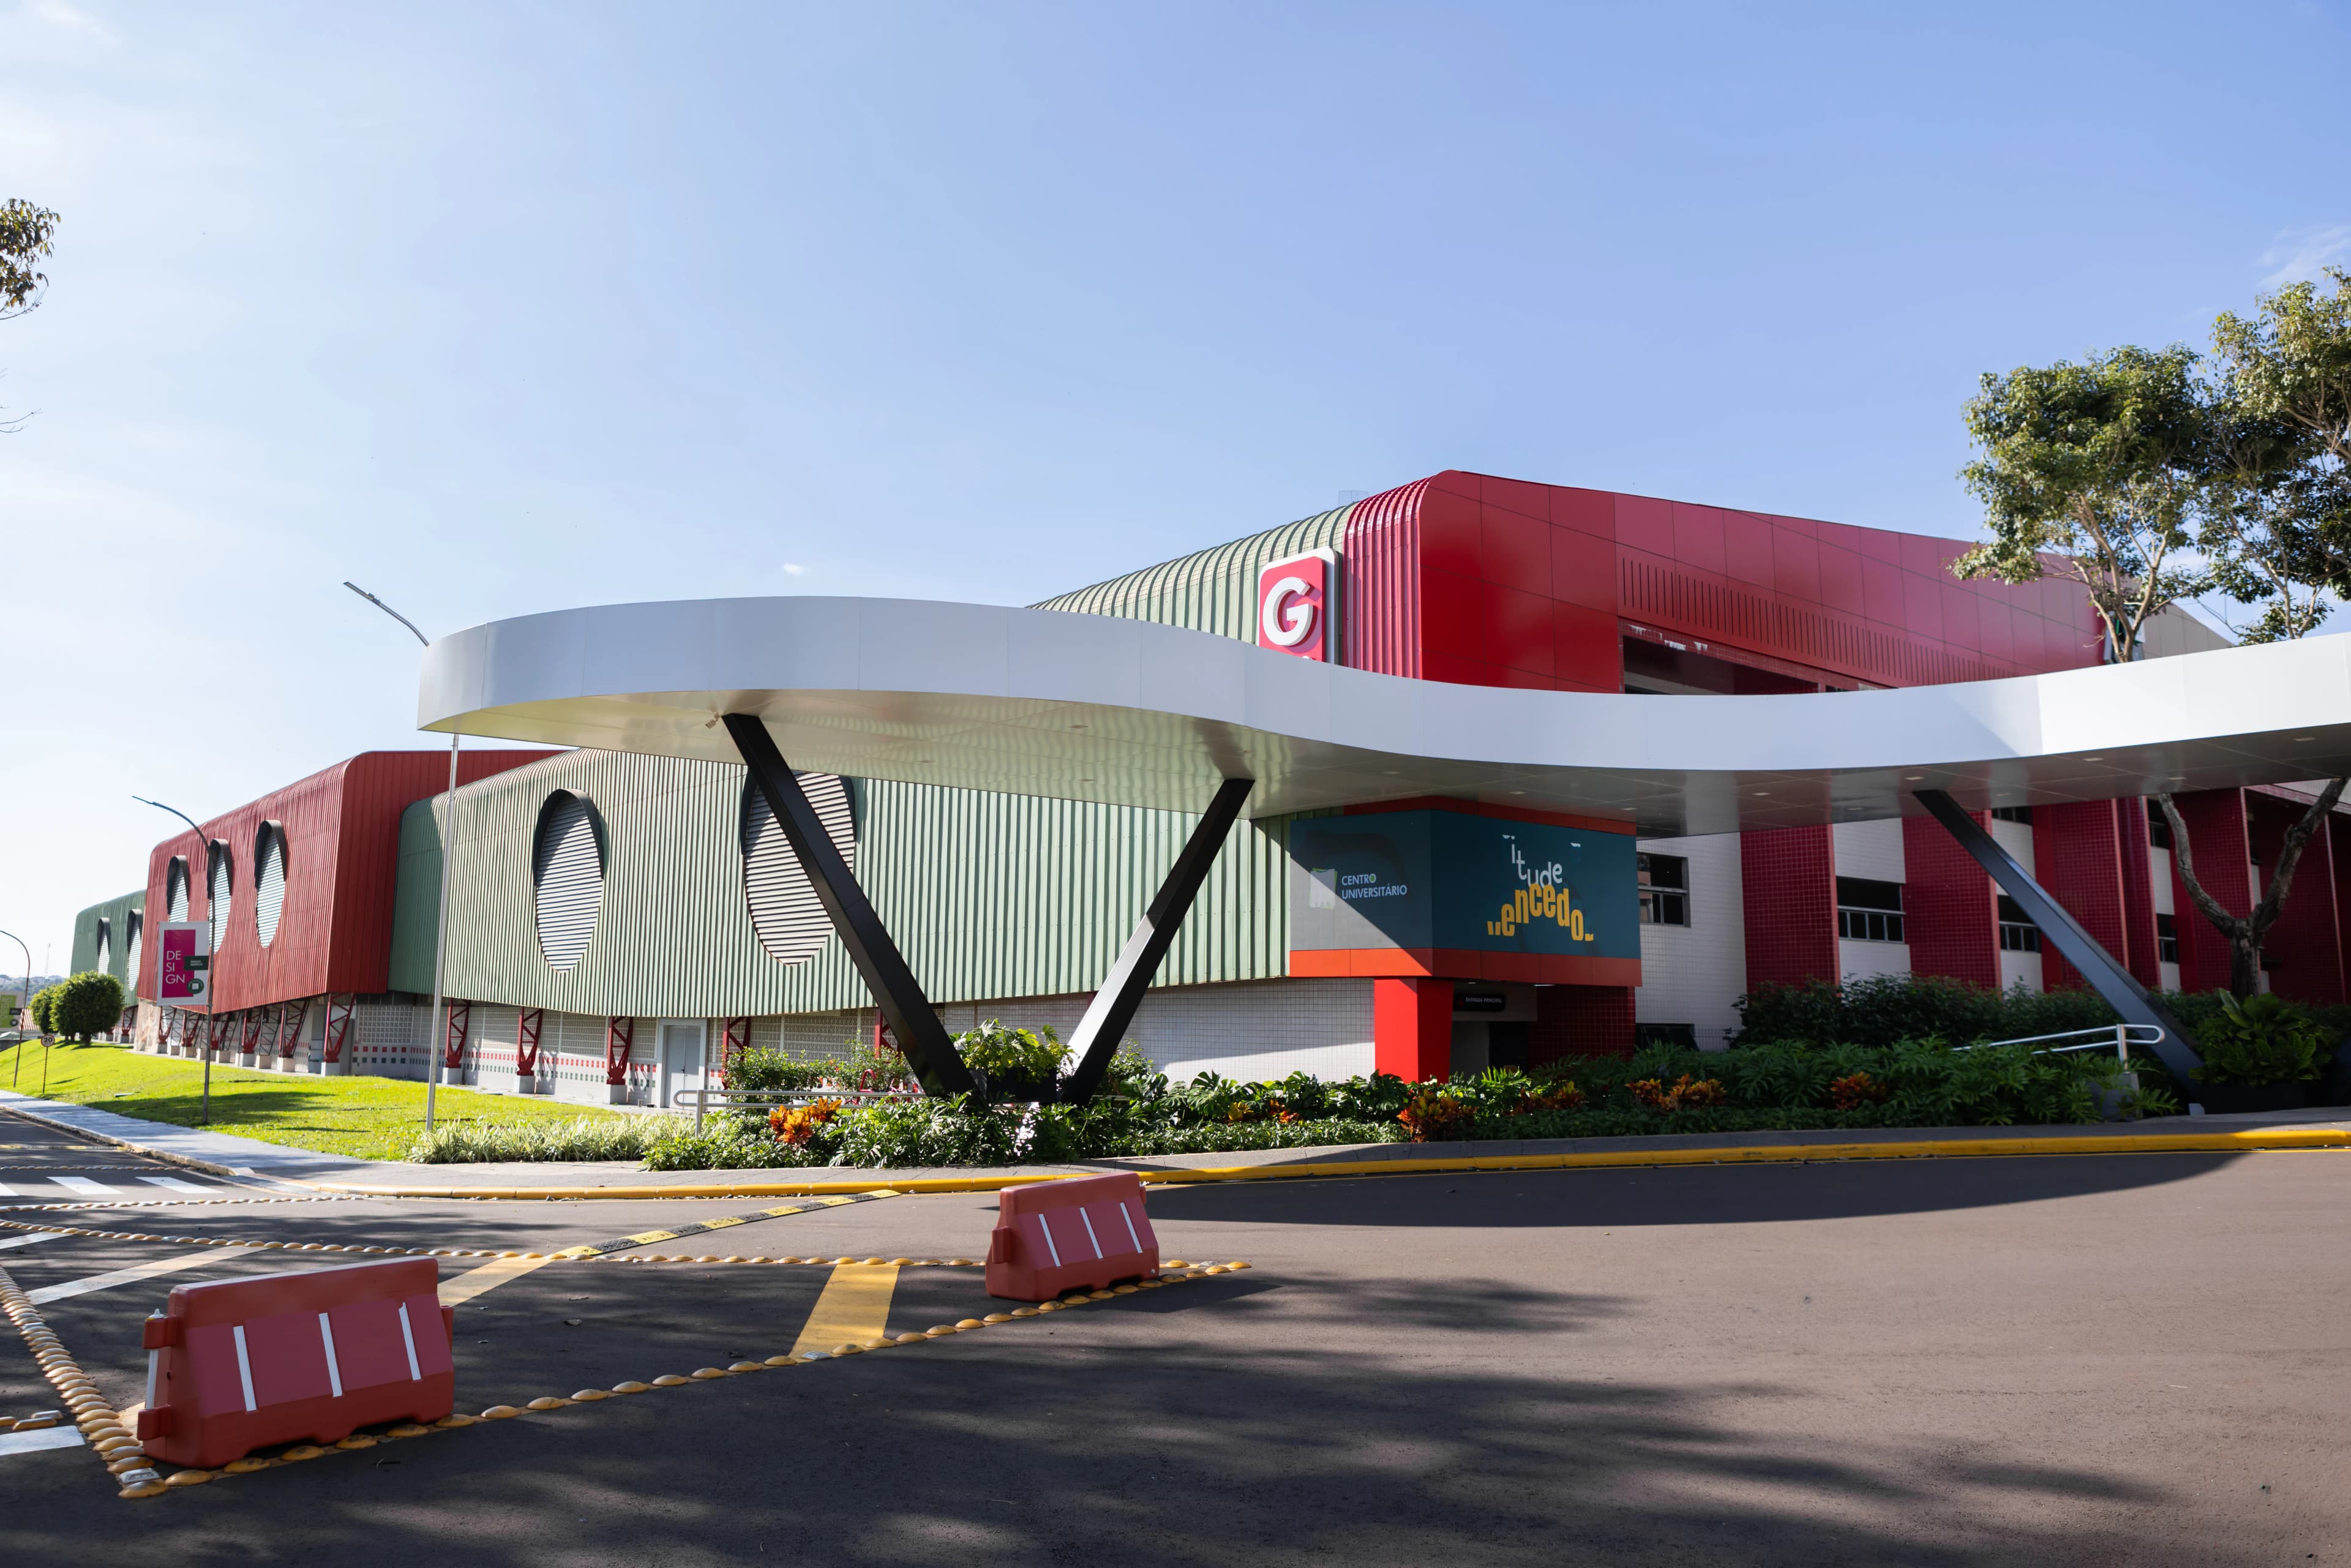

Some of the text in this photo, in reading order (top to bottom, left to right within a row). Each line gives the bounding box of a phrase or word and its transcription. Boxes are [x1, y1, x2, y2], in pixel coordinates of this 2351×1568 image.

[1262, 577, 1313, 647] G
[1341, 873, 1377, 886] CENTRO
[1341, 883, 1408, 899] UNIVERSITÁRIO
[167, 950, 181, 961] DE
[165, 962, 175, 972] SI
[165, 973, 186, 984] GN
